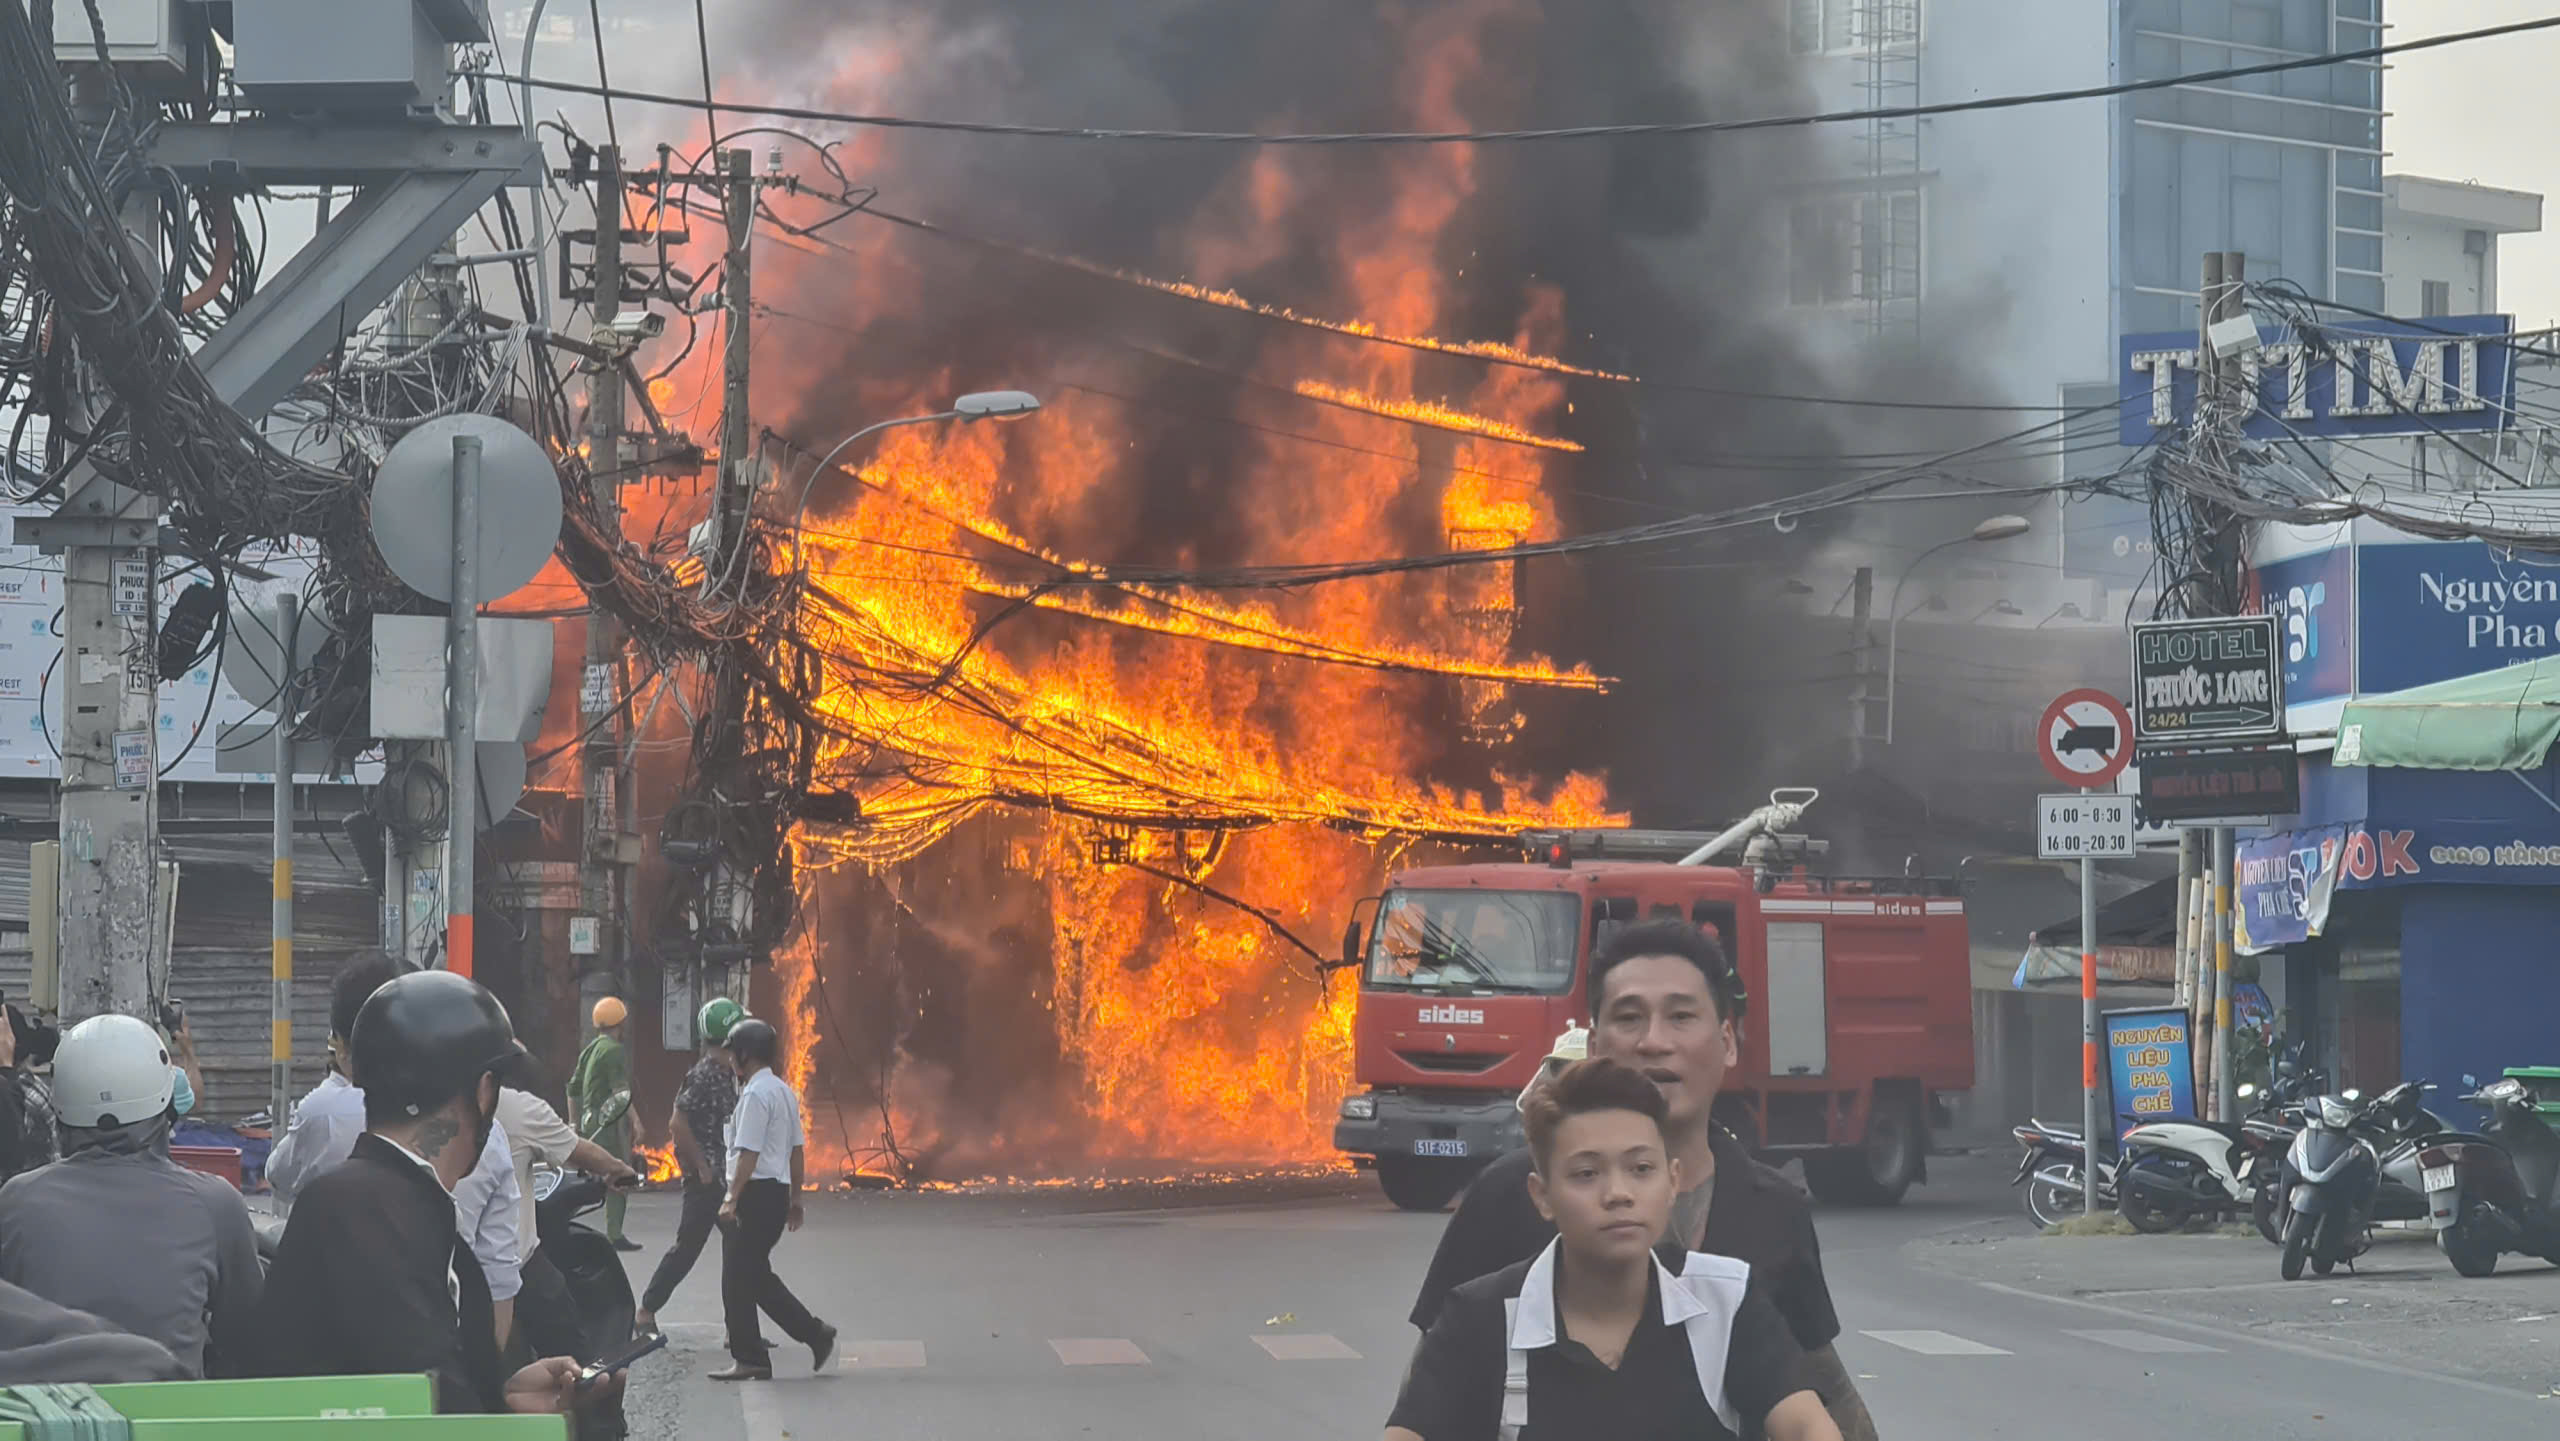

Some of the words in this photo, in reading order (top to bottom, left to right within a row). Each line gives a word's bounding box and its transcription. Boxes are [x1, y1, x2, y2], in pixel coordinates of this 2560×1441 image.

[2420, 570, 2558, 613] Nguyên
[2468, 614, 2546, 648] Pha
[2143, 628, 2267, 664] HOTEL
[2215, 669, 2269, 704] LONG
[2149, 712, 2187, 727] 24/24
[2050, 808, 2078, 823] 6:00
[2093, 808, 2121, 823] 8:30
[2047, 835, 2080, 850] 16:00
[2091, 835, 2125, 850] 20:30
[2430, 846, 2491, 865] GIAO
[1418, 1004, 1485, 1024] sides
[2112, 1024, 2184, 1046] NGUYÊN
[2131, 1070, 2171, 1089] PHA
[2133, 1089, 2173, 1113] CHẾ
